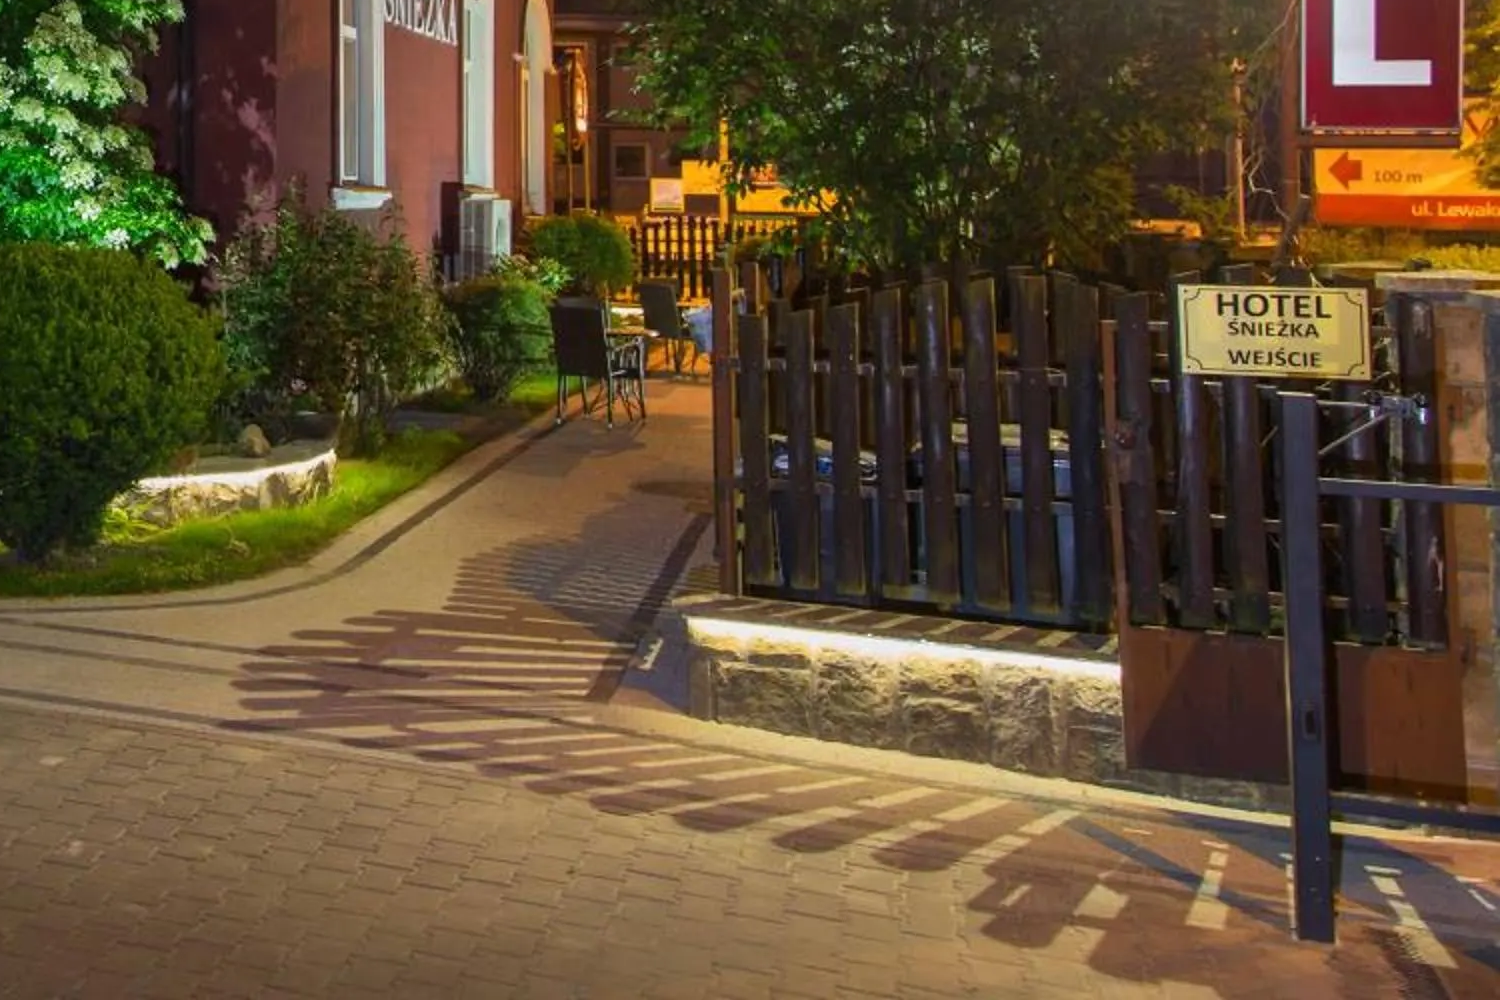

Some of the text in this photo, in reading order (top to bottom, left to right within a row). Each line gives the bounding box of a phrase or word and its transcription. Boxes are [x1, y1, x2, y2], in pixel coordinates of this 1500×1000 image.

[1373, 169, 1423, 184] 100 m
[1216, 293, 1332, 319] HOTEL
[1227, 318, 1319, 338] ŚNIEŻKA
[1227, 348, 1323, 369] WEJŚCIE
